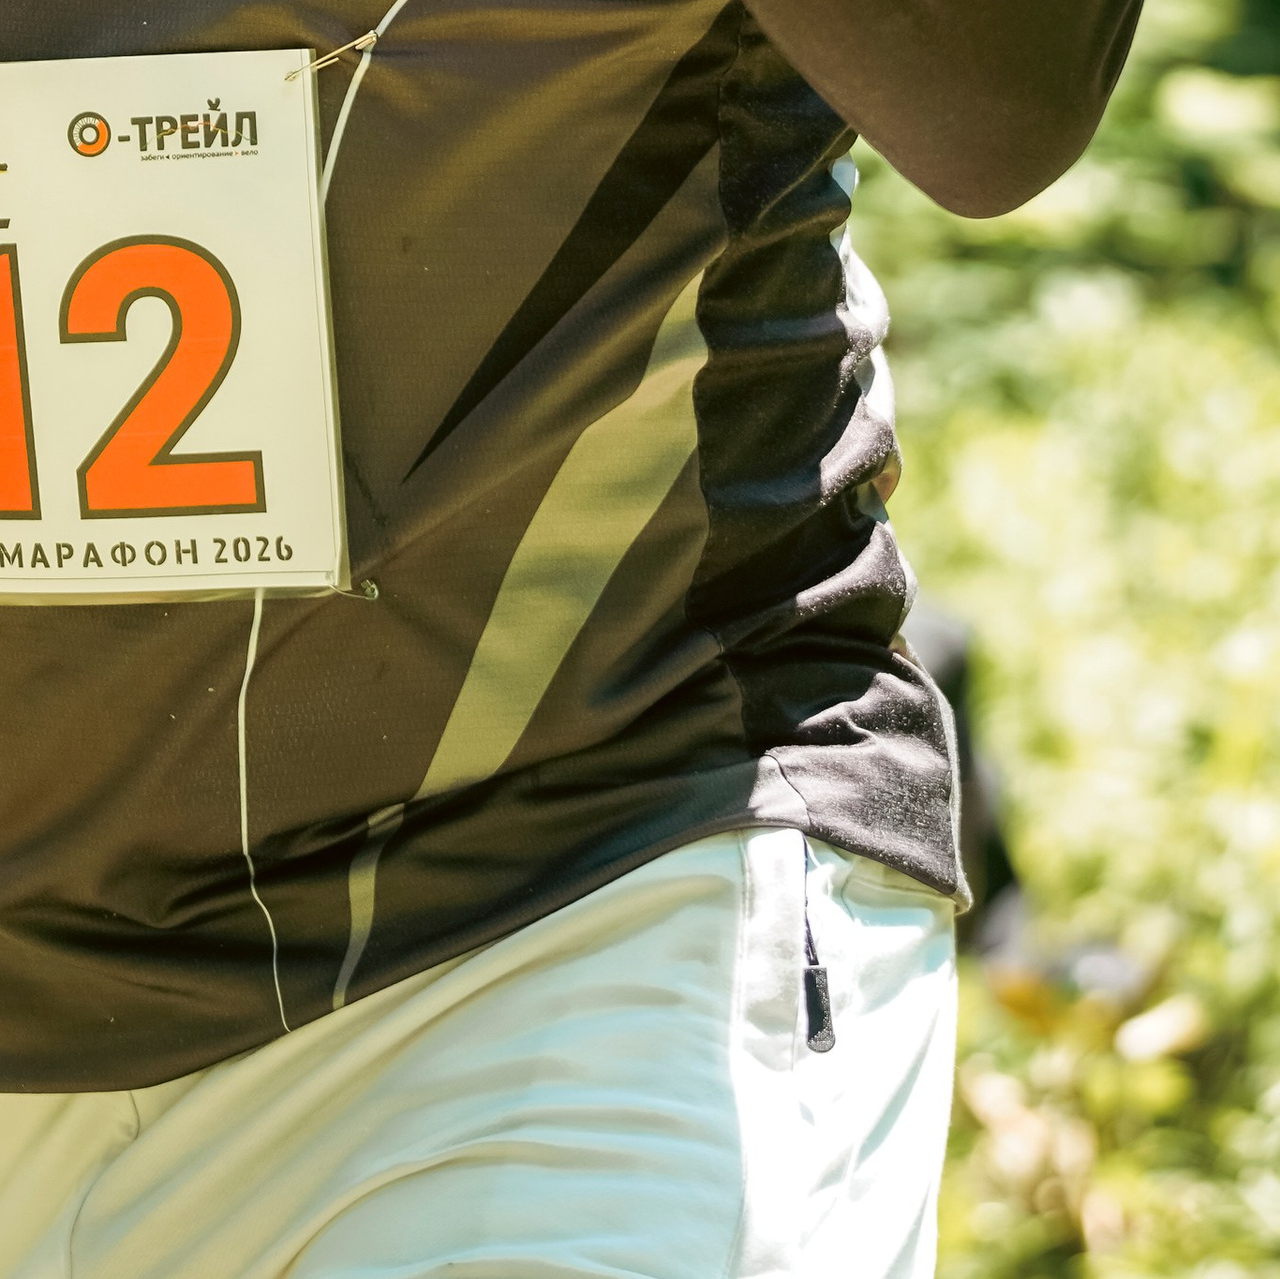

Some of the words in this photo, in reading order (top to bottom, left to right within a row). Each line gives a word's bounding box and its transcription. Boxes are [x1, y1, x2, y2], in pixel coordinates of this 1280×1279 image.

[140, 152, 165, 162] забеги
[171, 150, 234, 161] ориентирование
[240, 149, 259, 157] вело
[213, 534, 294, 563] 2026
